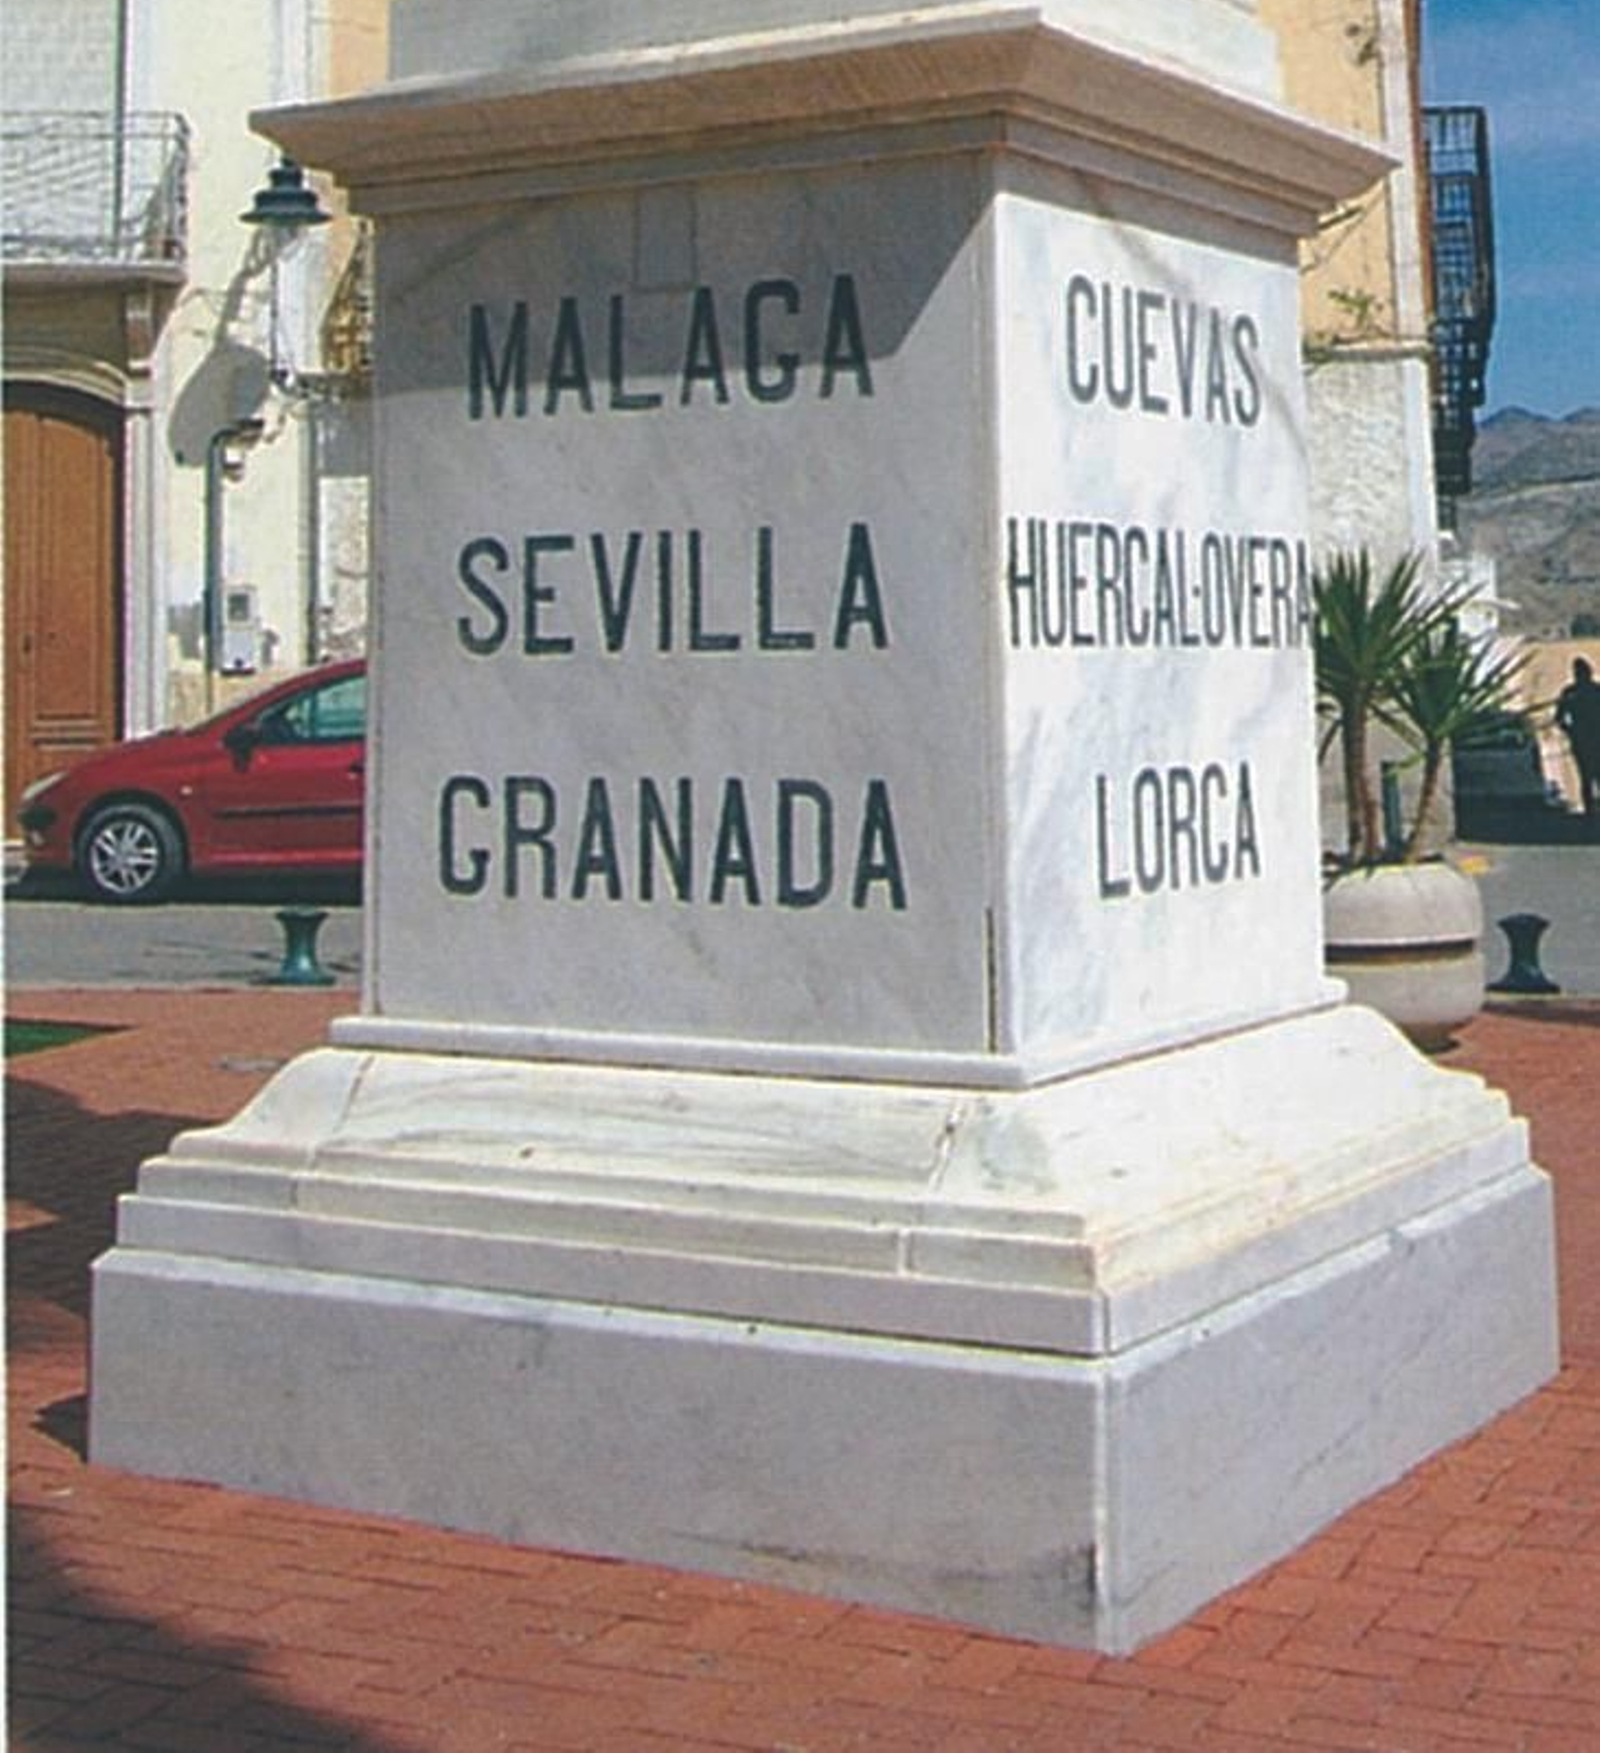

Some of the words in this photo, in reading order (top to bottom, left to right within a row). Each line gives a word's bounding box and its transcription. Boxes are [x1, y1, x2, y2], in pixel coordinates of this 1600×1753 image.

[467, 273, 874, 421] MALAGA
[1066, 274, 1262, 428] CUEVAS
[457, 522, 889, 656] SEVILLA
[439, 775, 908, 911] GRANADA
[1097, 760, 1261, 901] LORCA
